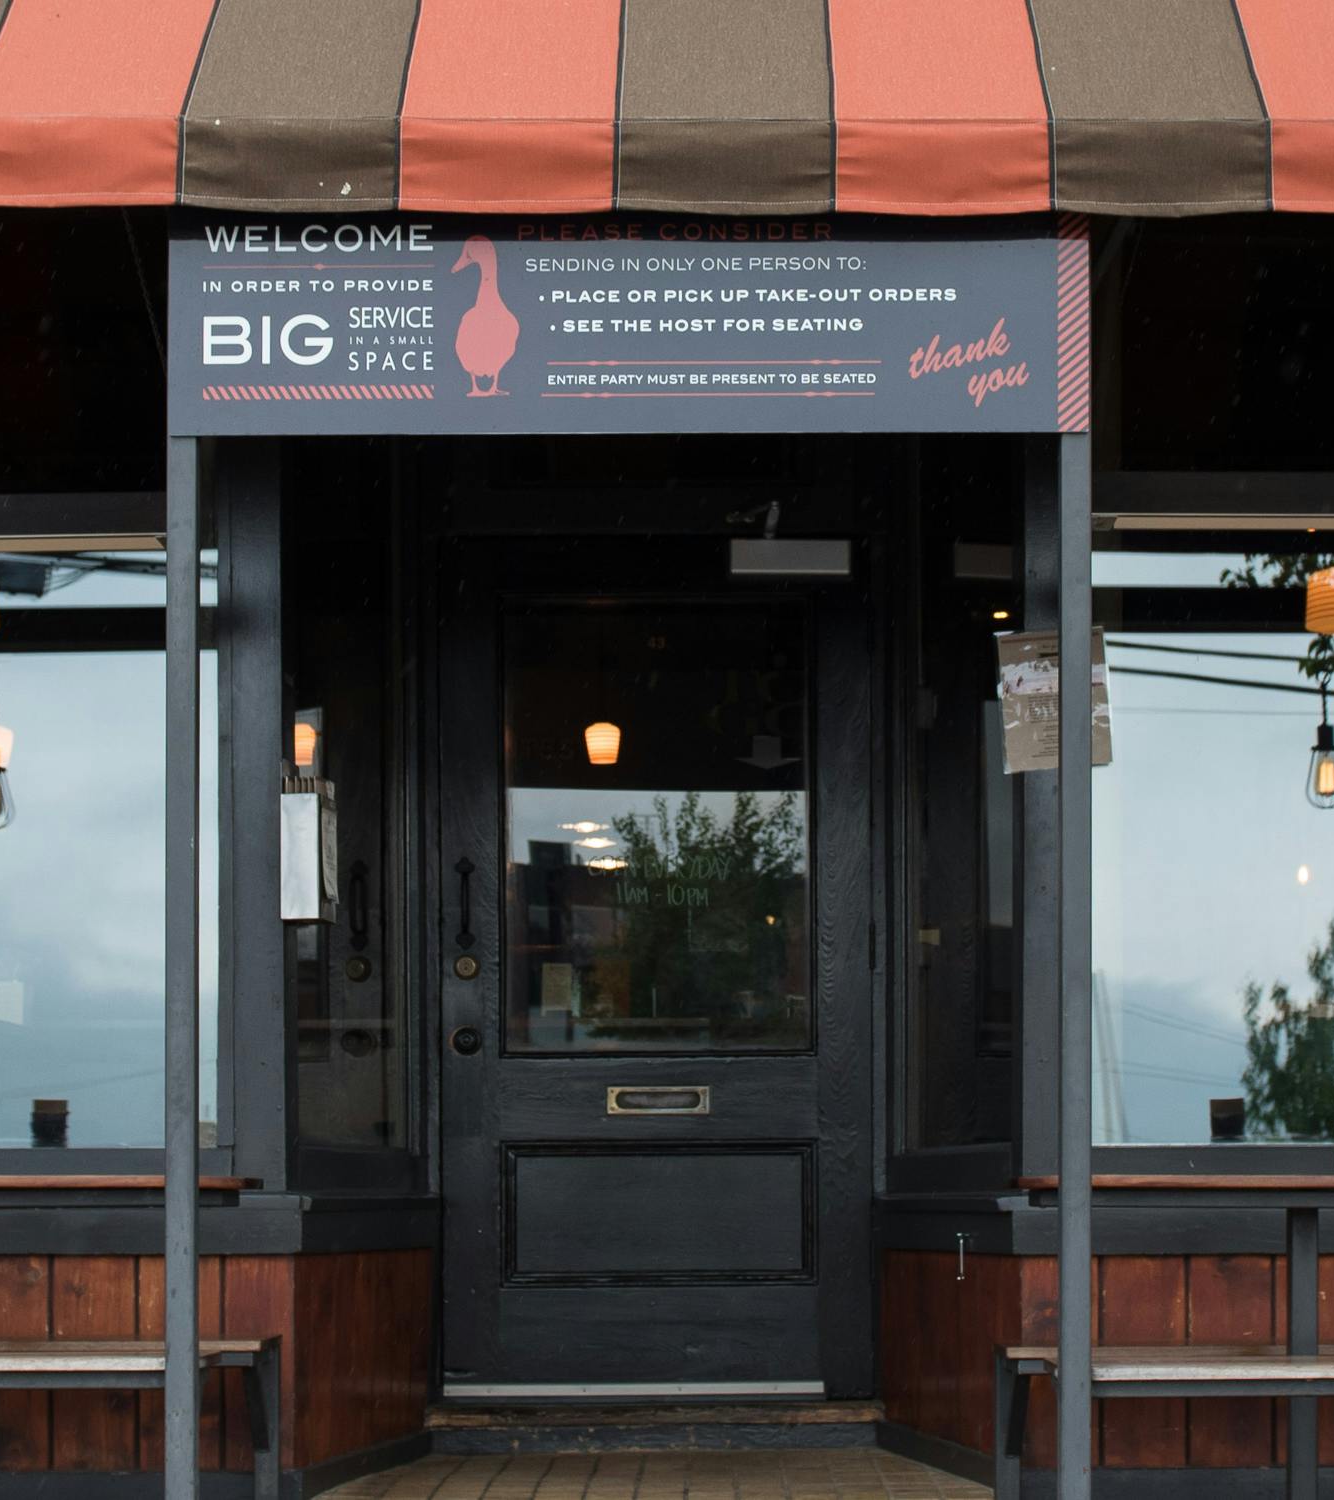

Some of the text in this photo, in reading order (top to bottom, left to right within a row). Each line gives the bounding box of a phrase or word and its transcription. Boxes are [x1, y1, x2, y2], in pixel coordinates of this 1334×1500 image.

[204, 224, 434, 253] WELCOME
[517, 222, 834, 241] PLEASE CONSIDER
[525, 256, 867, 273] SENDING IN ONLY ONE PERSON TO:
[202, 279, 434, 293] IN ORDER TO PROVIDE
[551, 287, 957, 304] PLACE OR PICK UP TAKE-OUT ORDERS
[348, 306, 435, 329] SERVICE
[562, 317, 864, 333] SEE THE HOST FOR SEATING
[202, 313, 335, 366] BIG
[349, 335, 434, 345] IN A SMALL
[907, 316, 1012, 380] thank
[347, 350, 435, 372] SPACE
[547, 372, 877, 386] ENTIRE PARTY MUST BE PRESENT TO BE SEATED
[966, 359, 1030, 408] you
[643, 854, 732, 881] EVERYDAY
